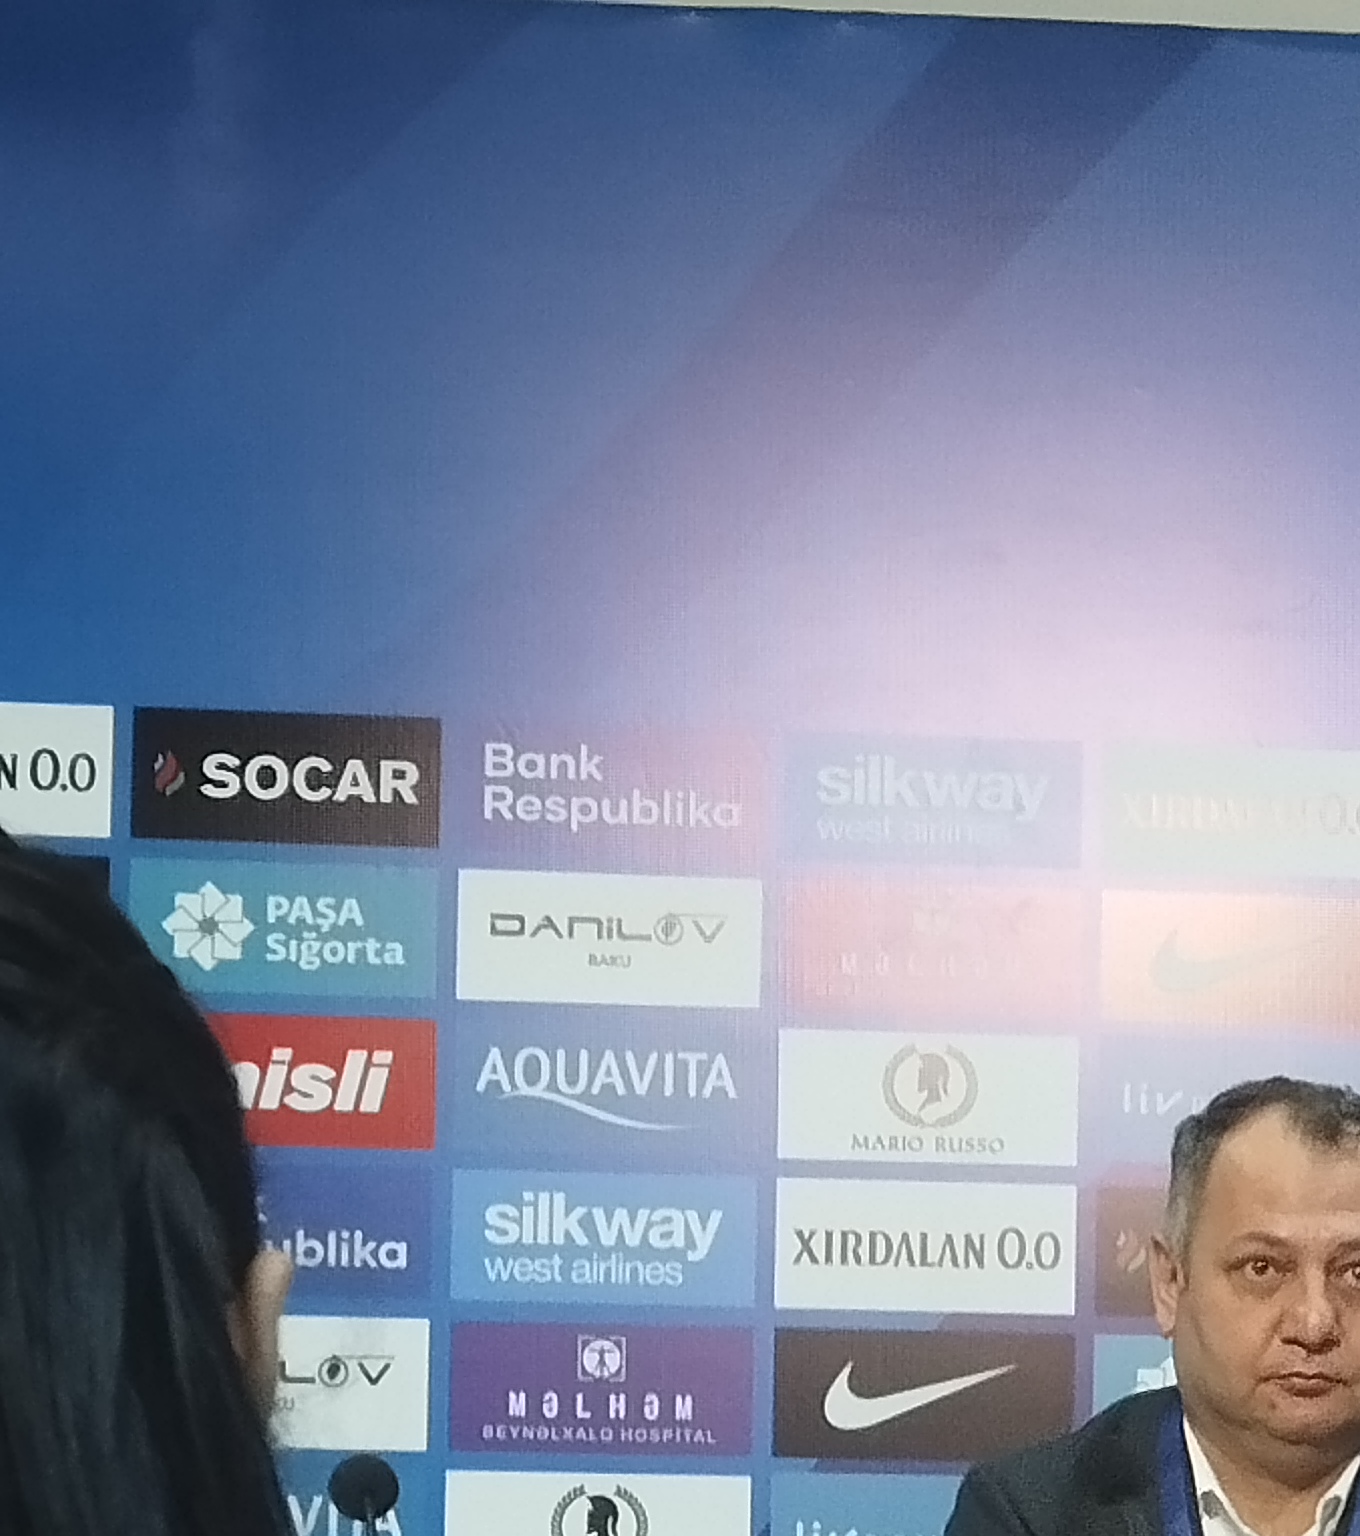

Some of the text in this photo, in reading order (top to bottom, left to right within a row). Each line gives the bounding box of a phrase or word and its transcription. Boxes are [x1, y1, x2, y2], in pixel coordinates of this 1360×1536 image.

[29, 747, 97, 794] 0.0
[199, 751, 419, 804] SOCAR
[483, 742, 604, 782] Bank
[483, 787, 743, 833] Respublika
[266, 895, 364, 933] PAŞA
[587, 953, 632, 969] BAKU
[476, 1046, 738, 1101] AQUAVITA
[851, 1132, 1005, 1155] MARIO RUSSO
[484, 1252, 684, 1288] west airlines
[792, 1227, 1061, 1271] XIRDALAN 0.0
